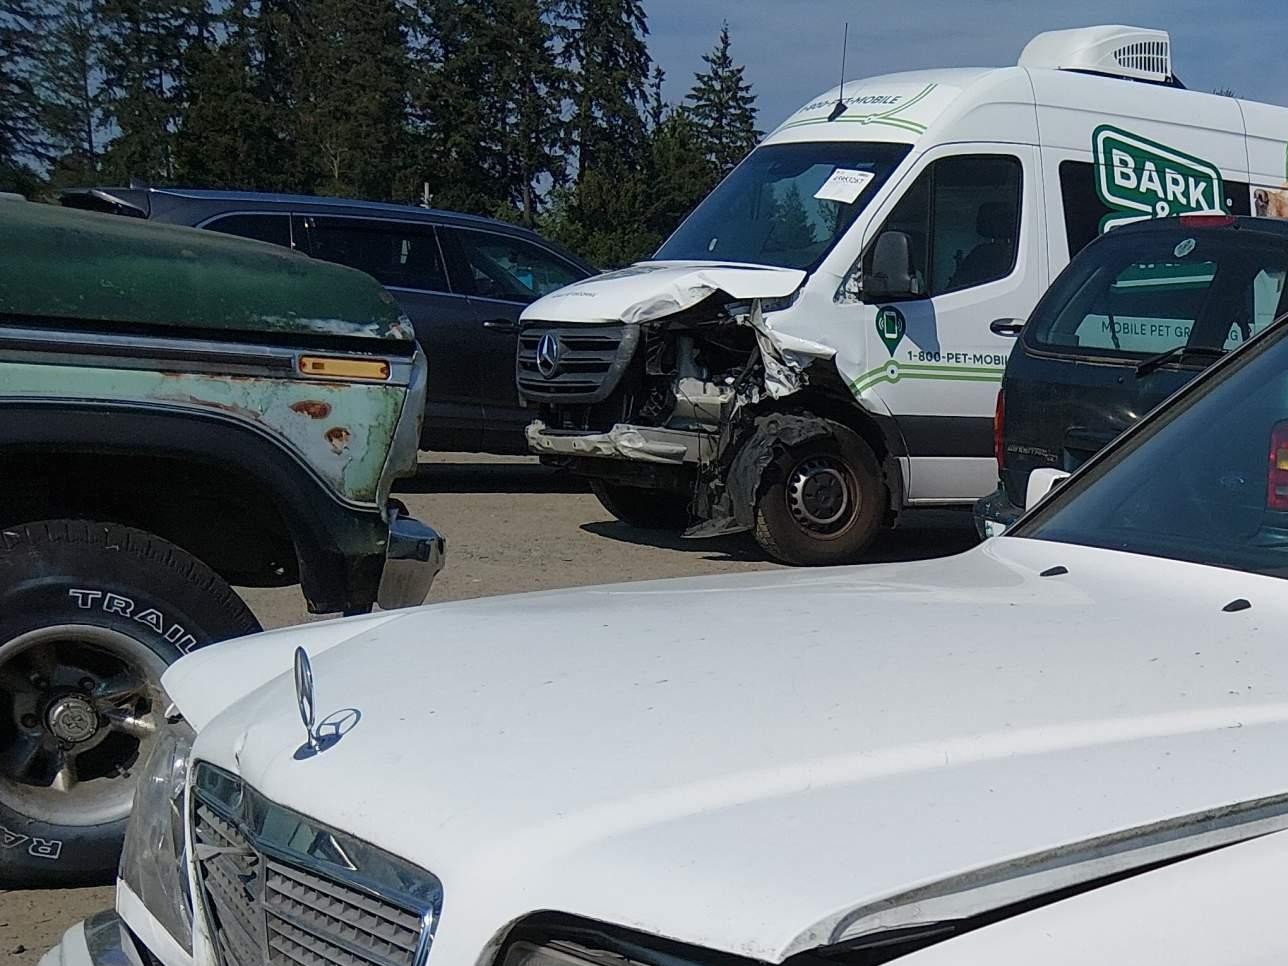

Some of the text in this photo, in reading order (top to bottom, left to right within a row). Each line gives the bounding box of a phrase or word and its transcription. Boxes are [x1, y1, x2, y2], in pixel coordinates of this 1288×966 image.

[1112, 149, 1209, 212] BARK
[1102, 321, 1147, 336] MOBILE
[1150, 324, 1171, 337] PET
